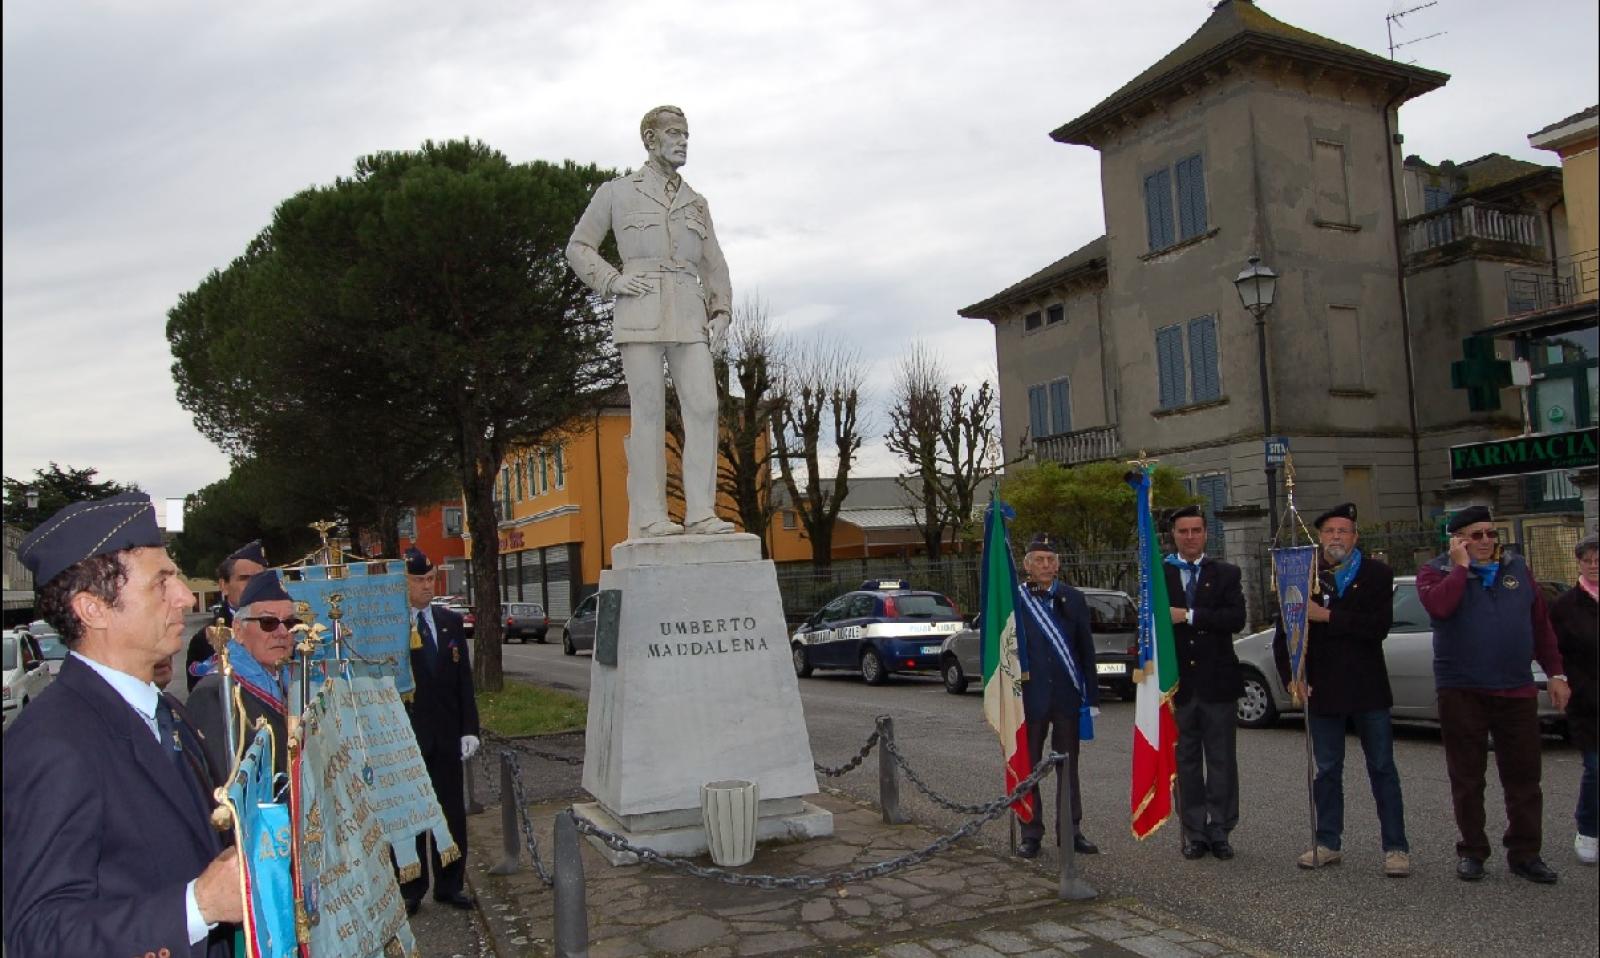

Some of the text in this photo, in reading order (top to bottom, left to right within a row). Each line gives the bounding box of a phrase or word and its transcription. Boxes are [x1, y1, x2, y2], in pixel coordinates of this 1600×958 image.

[1454, 432, 1597, 469] FARMACIA
[660, 617, 757, 636] UMBERTO
[647, 637, 769, 659] MADDALENA
